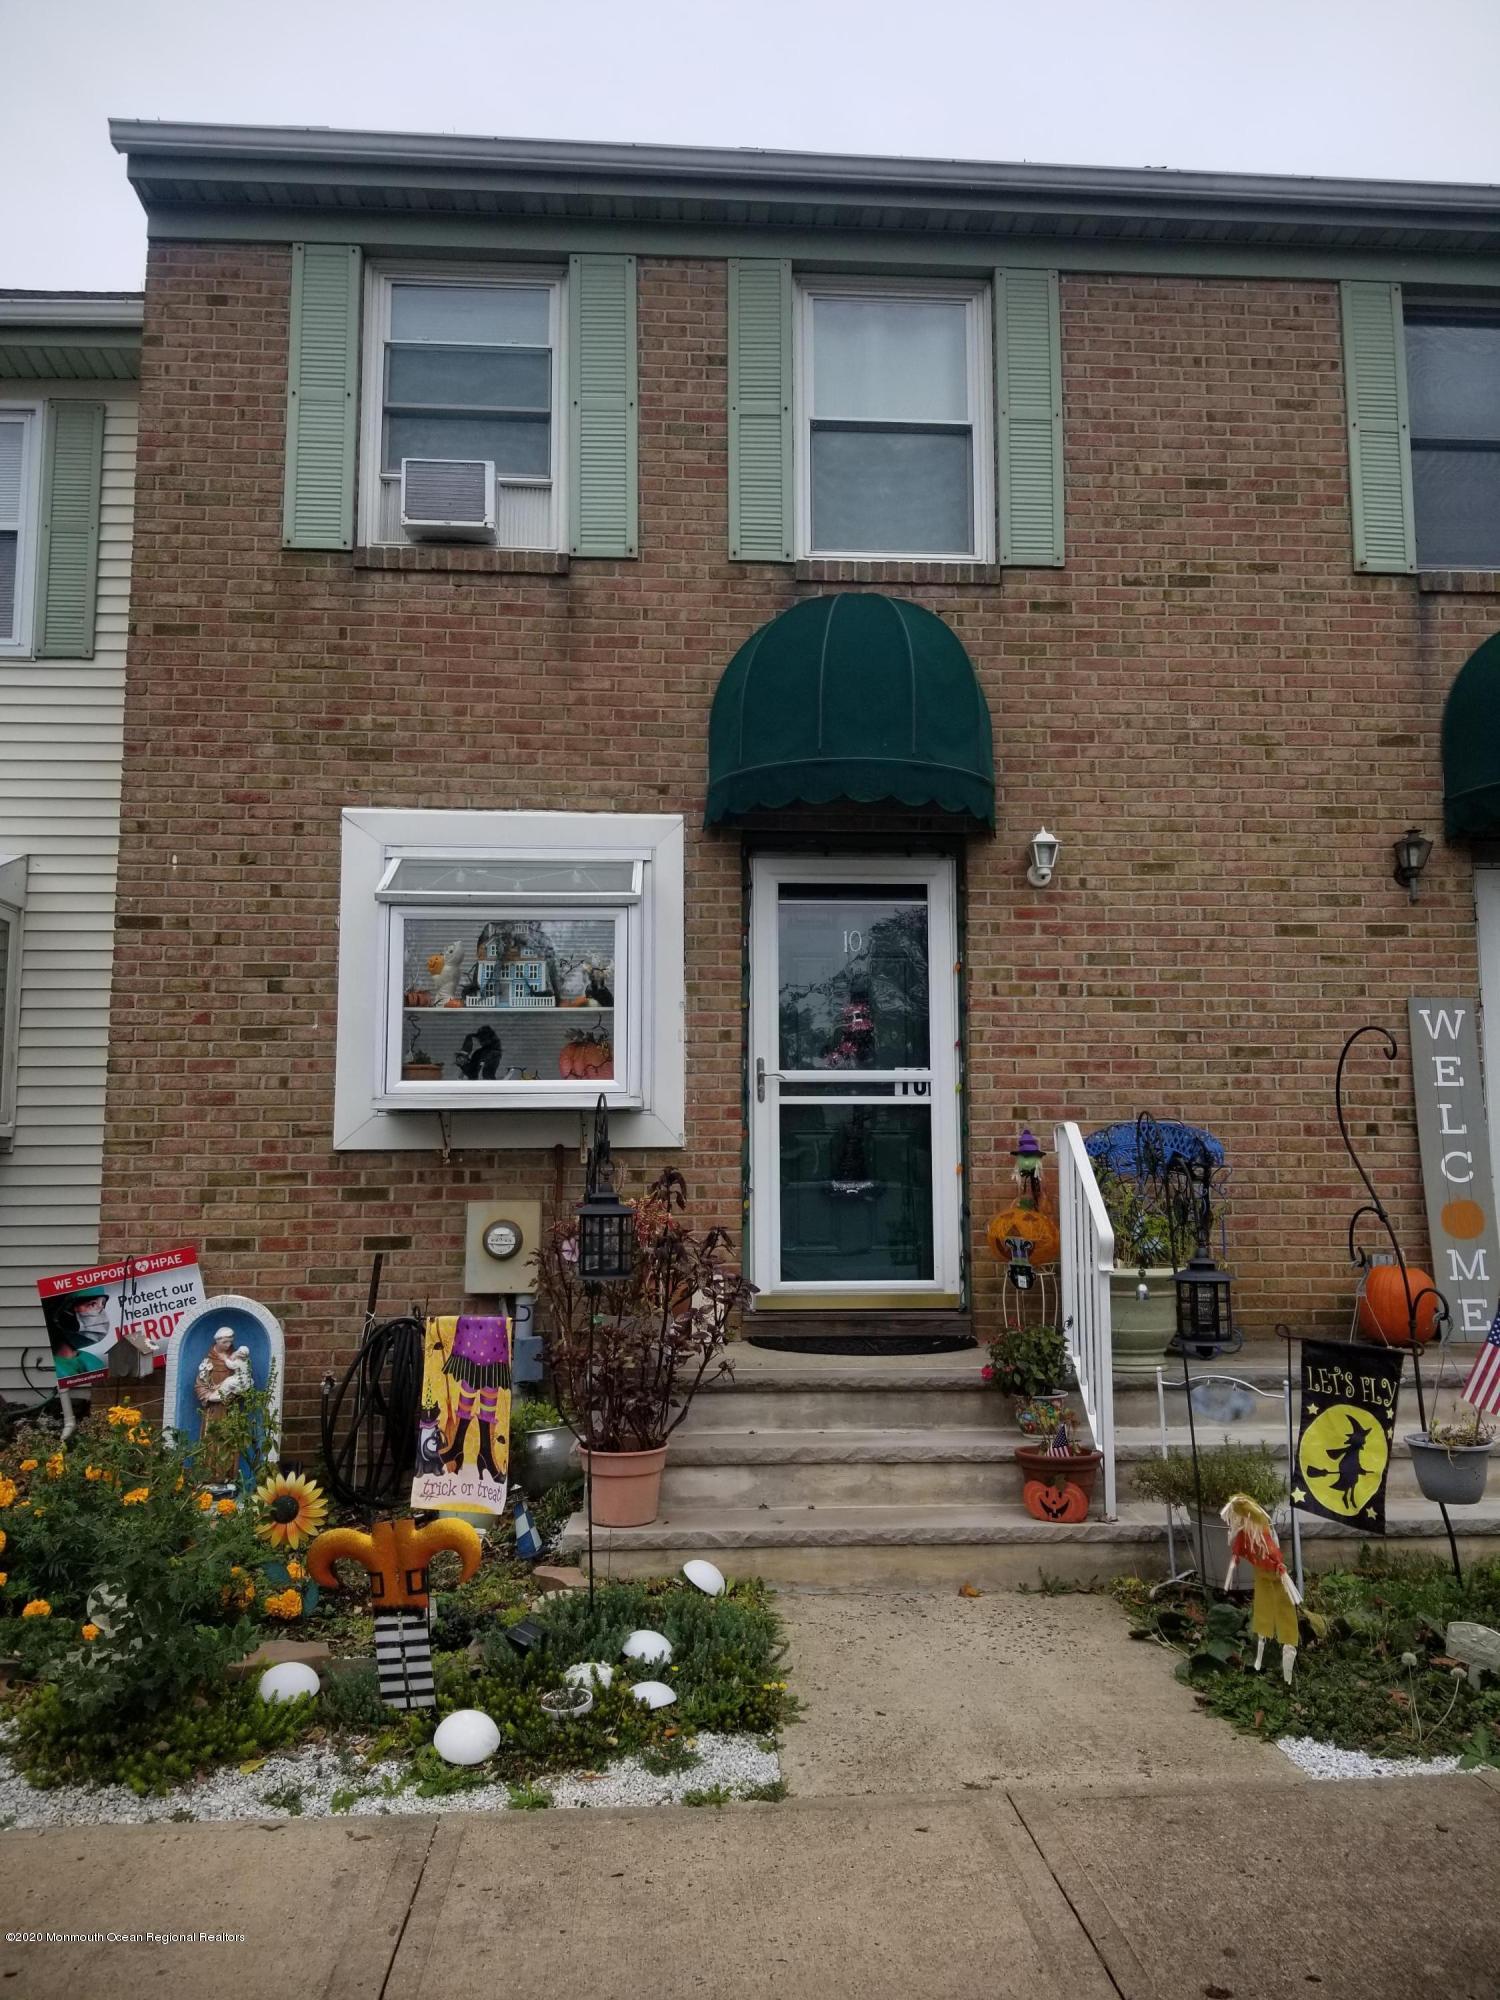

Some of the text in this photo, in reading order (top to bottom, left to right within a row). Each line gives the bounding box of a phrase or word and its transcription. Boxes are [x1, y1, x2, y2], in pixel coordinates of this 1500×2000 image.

[843, 930, 862, 953] 10
[1418, 1009, 1491, 1332] WELCME
[53, 1253, 183, 1291] WE SUPPORT HPAE
[118, 1281, 194, 1308] Protect our
[124, 1296, 197, 1321] healthcare
[1306, 1365, 1398, 1408] LET'S FLY
[423, 1479, 458, 1497] trick
[461, 1482, 474, 1496] or
